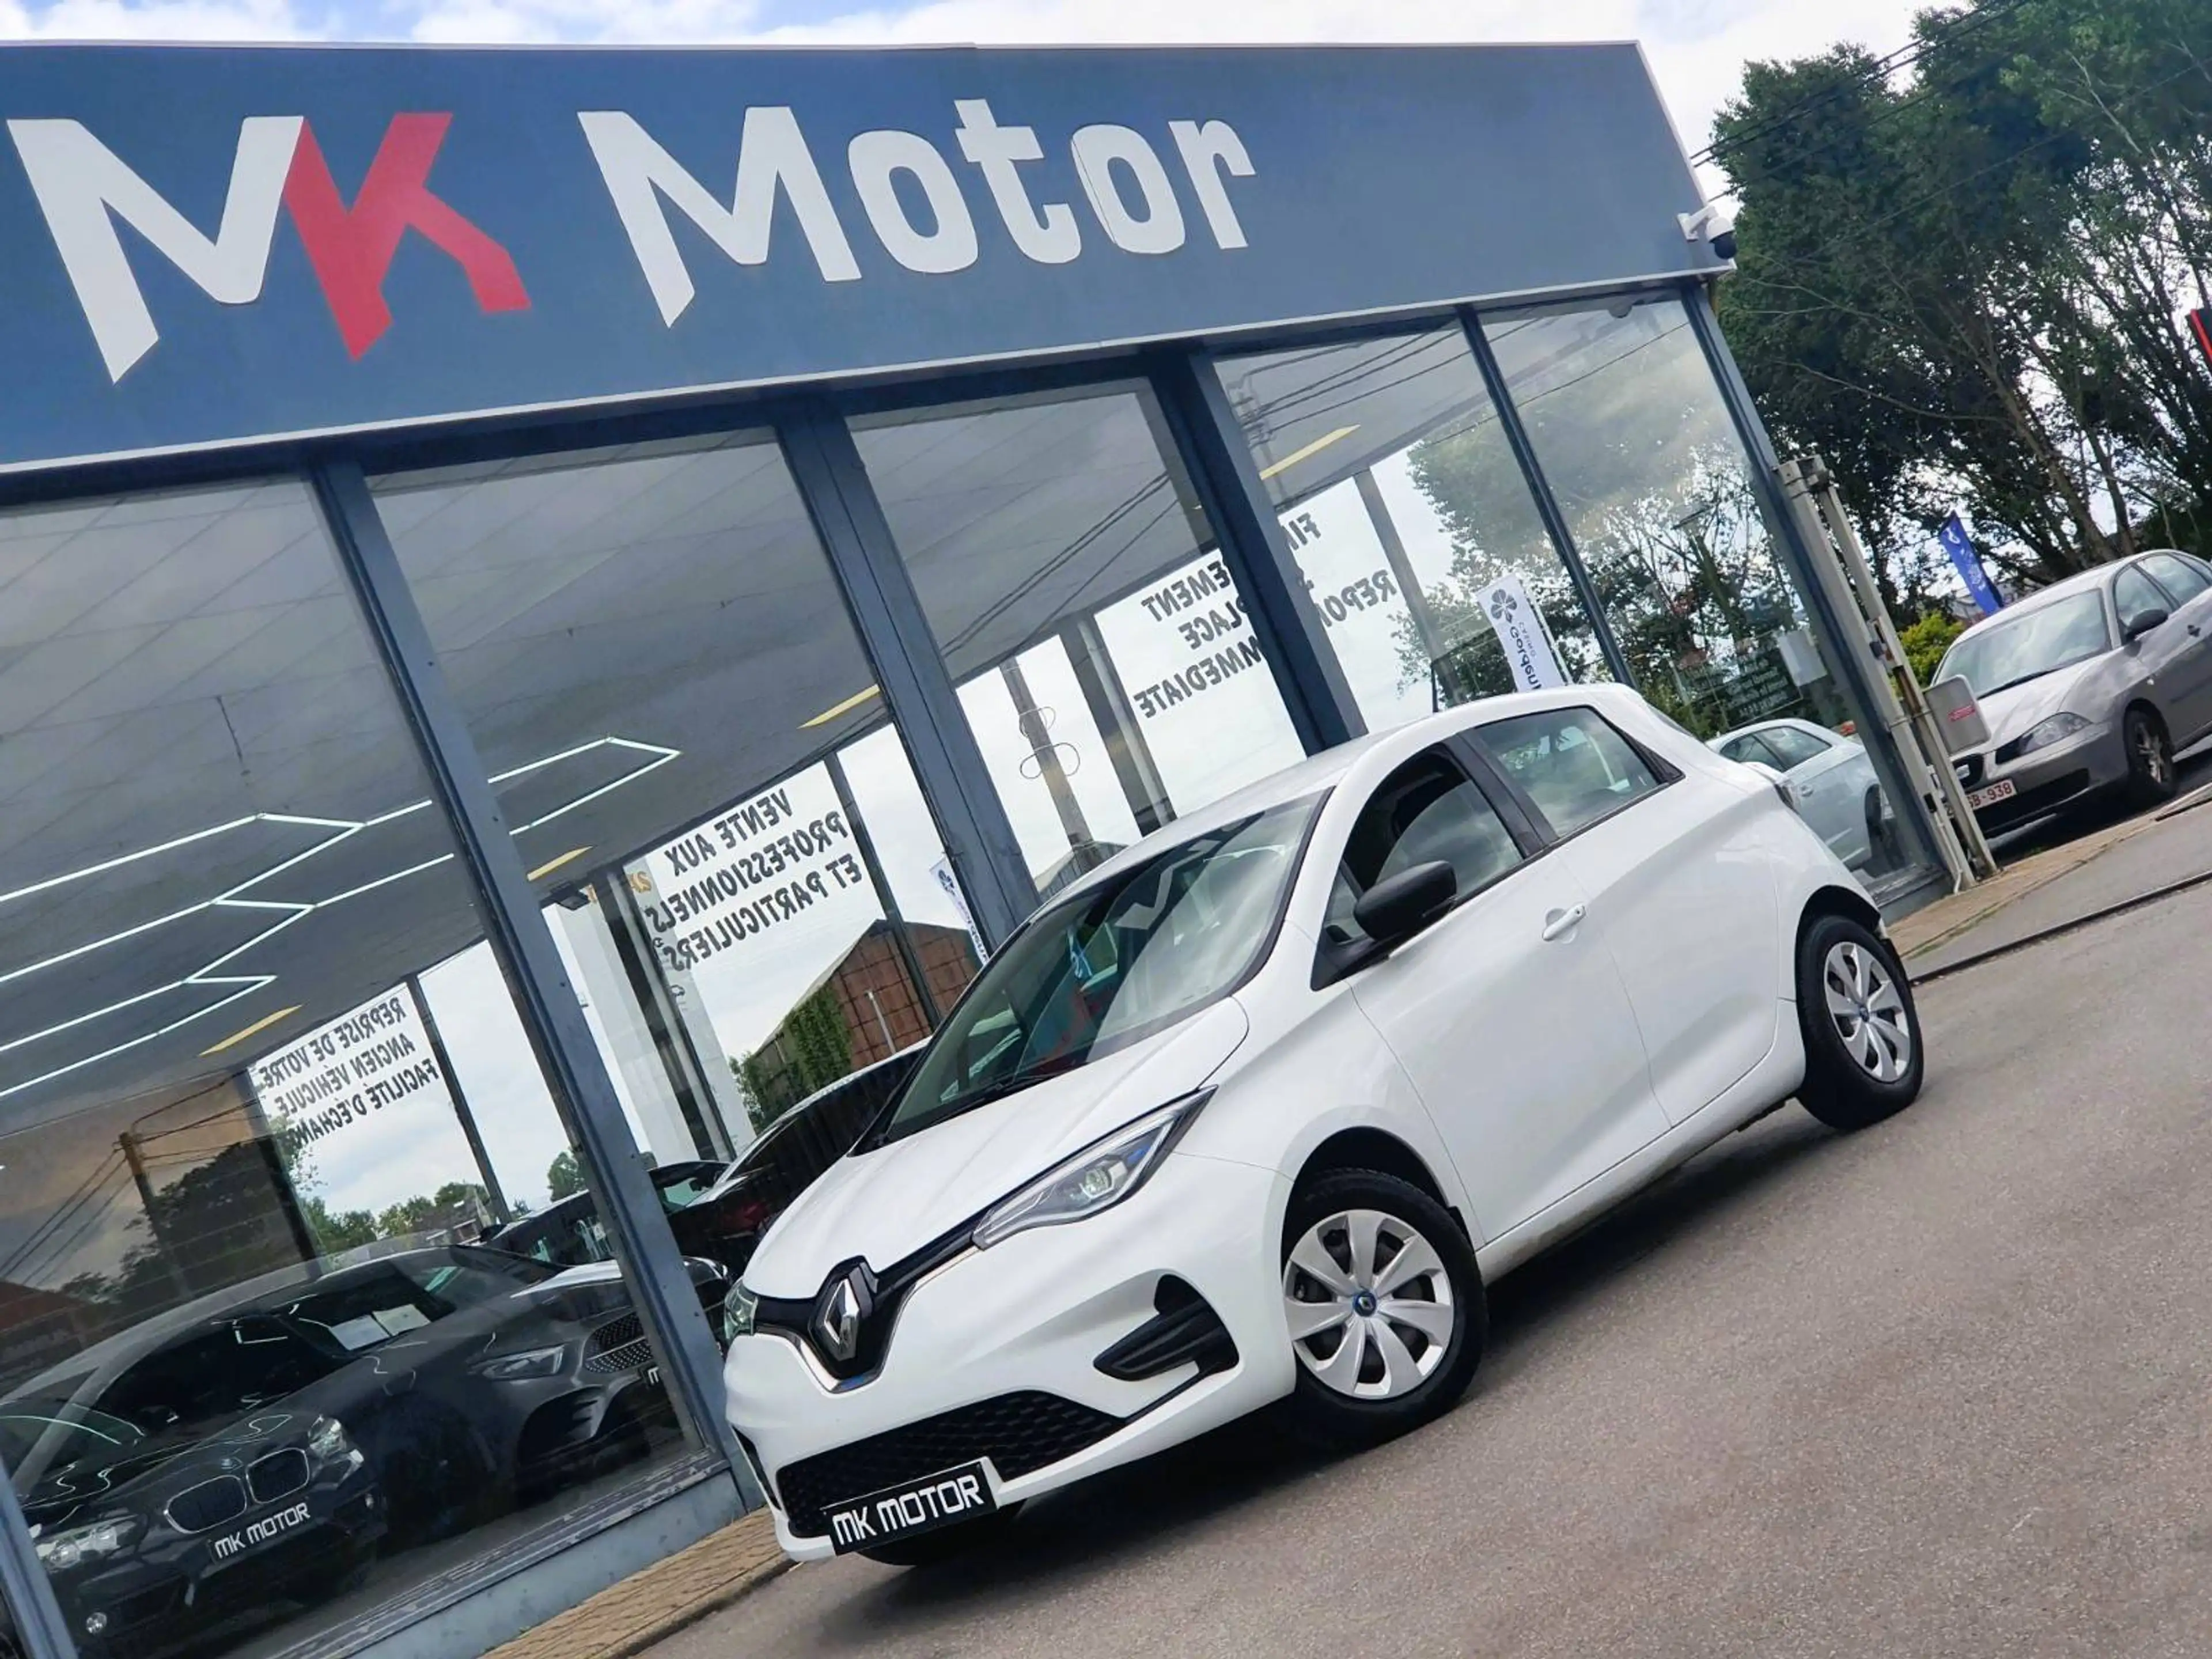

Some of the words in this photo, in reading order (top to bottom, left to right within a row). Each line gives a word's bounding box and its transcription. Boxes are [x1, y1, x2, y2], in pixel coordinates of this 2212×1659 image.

[6, 112, 532, 385] MK
[577, 99, 1257, 329] Motor
[215, 1531, 246, 1559] MK
[247, 1502, 310, 1543] MOTOR
[832, 1506, 877, 1545] MK
[877, 1475, 984, 1532] MOTOR
